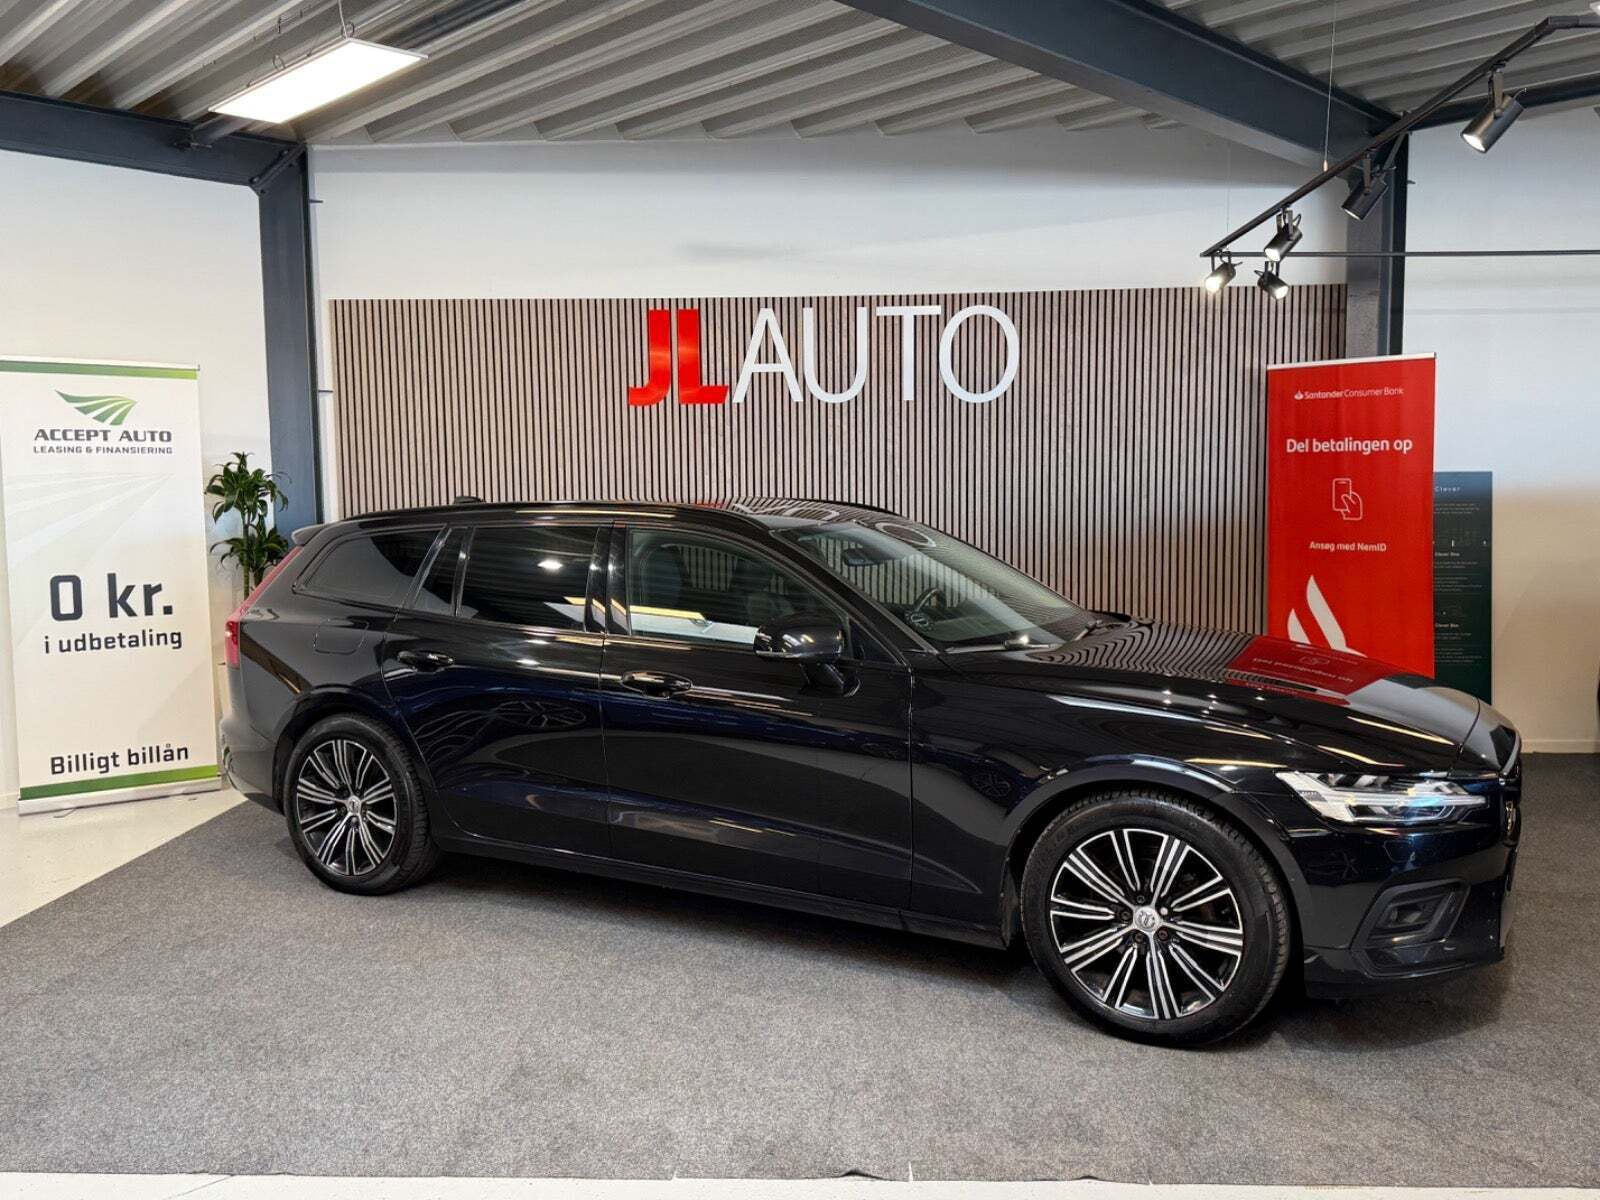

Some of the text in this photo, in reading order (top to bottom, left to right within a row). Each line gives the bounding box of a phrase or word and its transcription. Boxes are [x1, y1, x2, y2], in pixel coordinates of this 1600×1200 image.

[1384, 386, 1404, 396] Bank
[34, 428, 172, 442] ACCEPT AUTO
[33, 445, 173, 455] LEASING & FINANSIERING
[1286, 437, 1413, 455] Del betalingen op
[1310, 541, 1387, 552] Ansøg med NemID
[50, 573, 173, 622] 0 kr.
[44, 629, 182, 654] i udbetaling
[50, 743, 189, 775] Billigt billån
